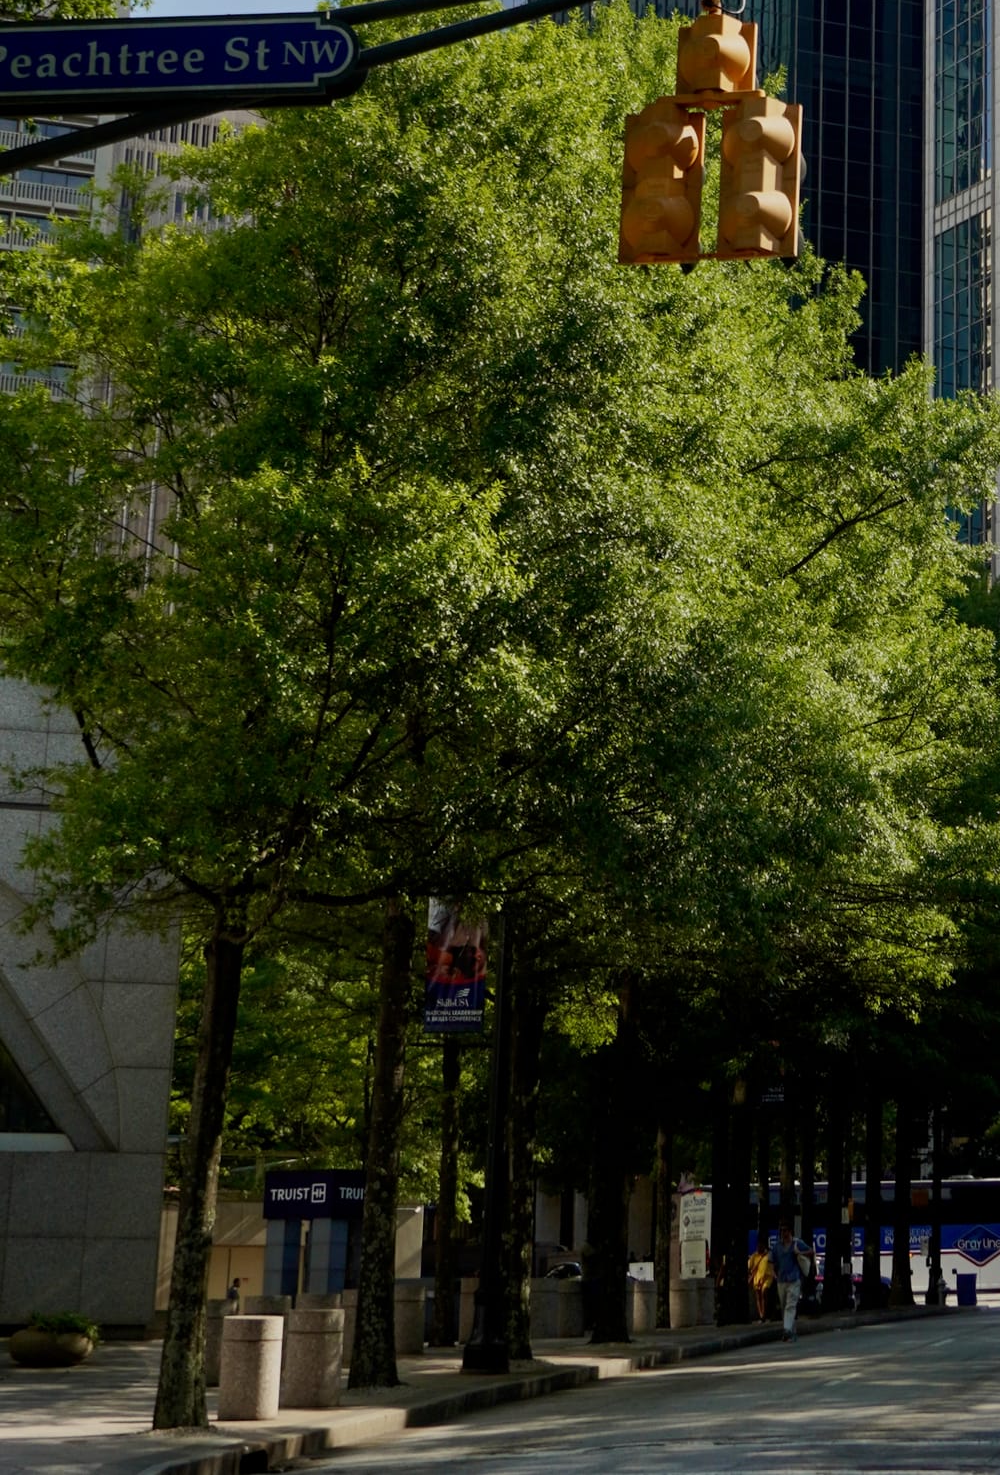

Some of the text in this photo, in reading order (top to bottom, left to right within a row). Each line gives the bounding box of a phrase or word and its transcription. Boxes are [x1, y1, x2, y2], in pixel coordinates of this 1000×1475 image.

[223, 36, 272, 73] St
[283, 39, 342, 66] NW
[269, 1186, 310, 1202] TRUIST
[338, 1186, 366, 1201] TRUI
[957, 1238, 982, 1251] Gray
